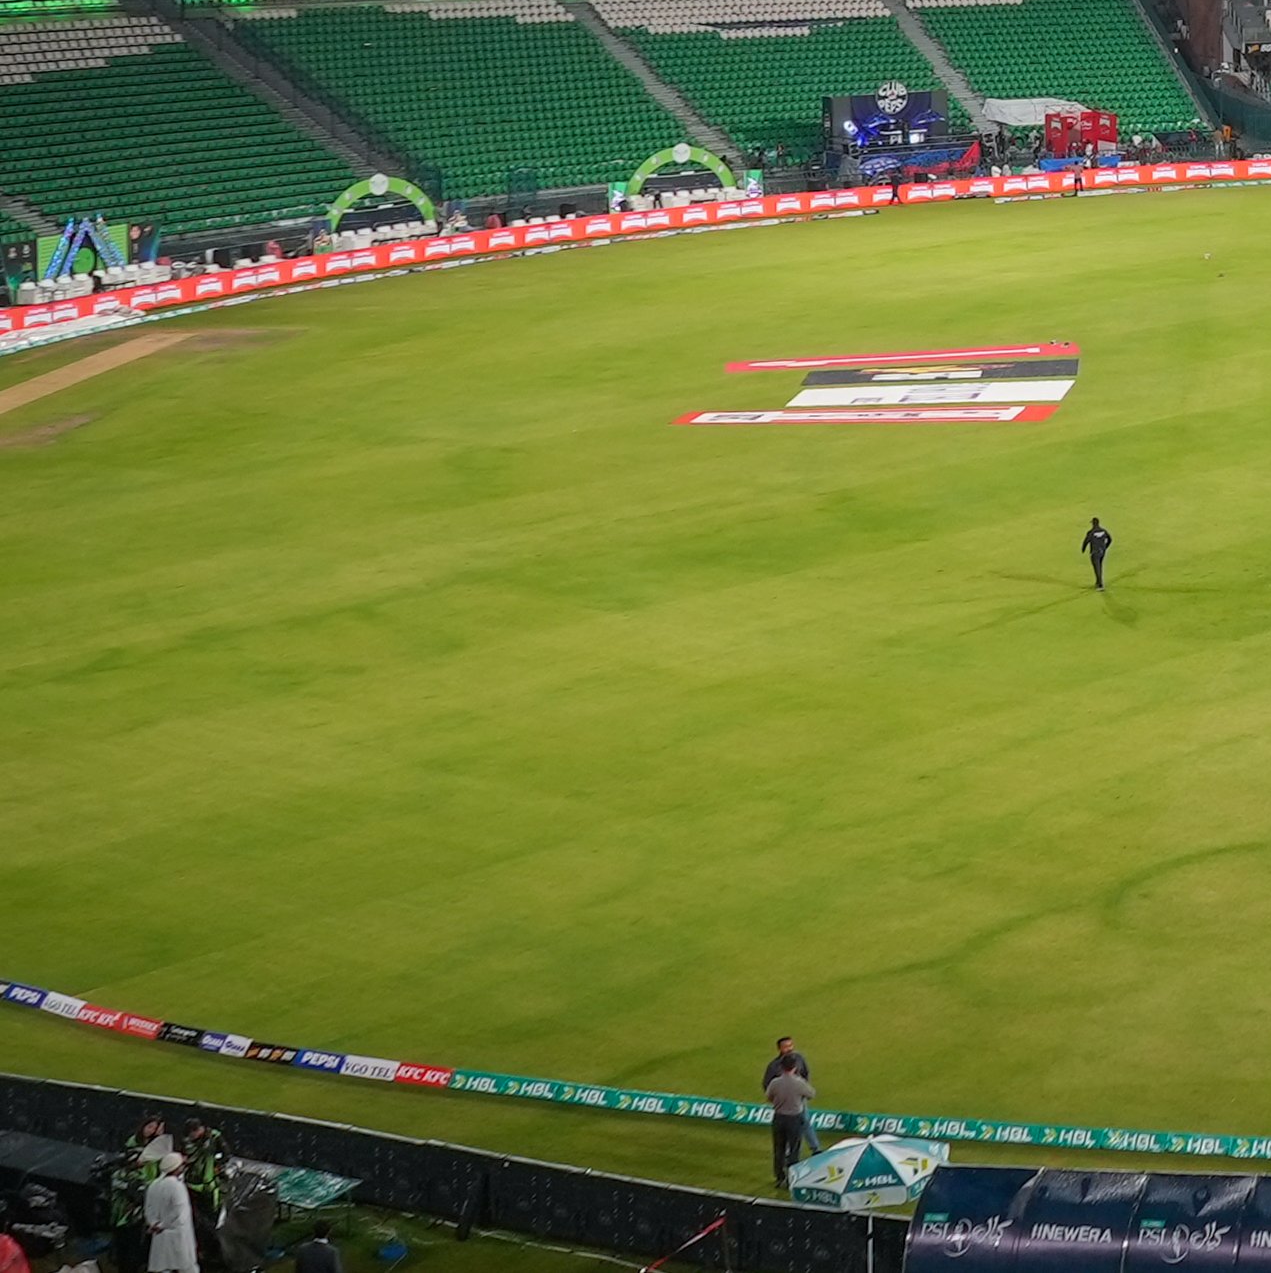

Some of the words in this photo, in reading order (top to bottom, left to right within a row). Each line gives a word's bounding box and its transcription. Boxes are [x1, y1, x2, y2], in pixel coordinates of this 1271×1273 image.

[878, 81, 908, 96] CLUB
[877, 99, 907, 115] PEPSI
[9, 987, 41, 1005] PEPSI
[77, 1008, 99, 1023] KFC
[300, 1051, 341, 1068] PEPSI
[395, 1065, 425, 1080] KFC
[421, 1071, 452, 1085] KFC
[465, 1076, 498, 1093] HBL
[520, 1082, 553, 1098] HBL
[575, 1089, 608, 1106] HBL
[631, 1096, 667, 1113] HBL
[690, 1101, 726, 1119] HBL
[809, 1112, 846, 1129] HBL
[870, 1118, 907, 1134] HBL
[934, 1120, 971, 1137] HBL
[996, 1125, 1033, 1142] HBL
[1058, 1129, 1096, 1147] HBL
[1123, 1132, 1163, 1151] HBL
[1187, 1137, 1226, 1154] HBL
[864, 1174, 898, 1185] HBL
[1137, 1228, 1172, 1247] PSL
